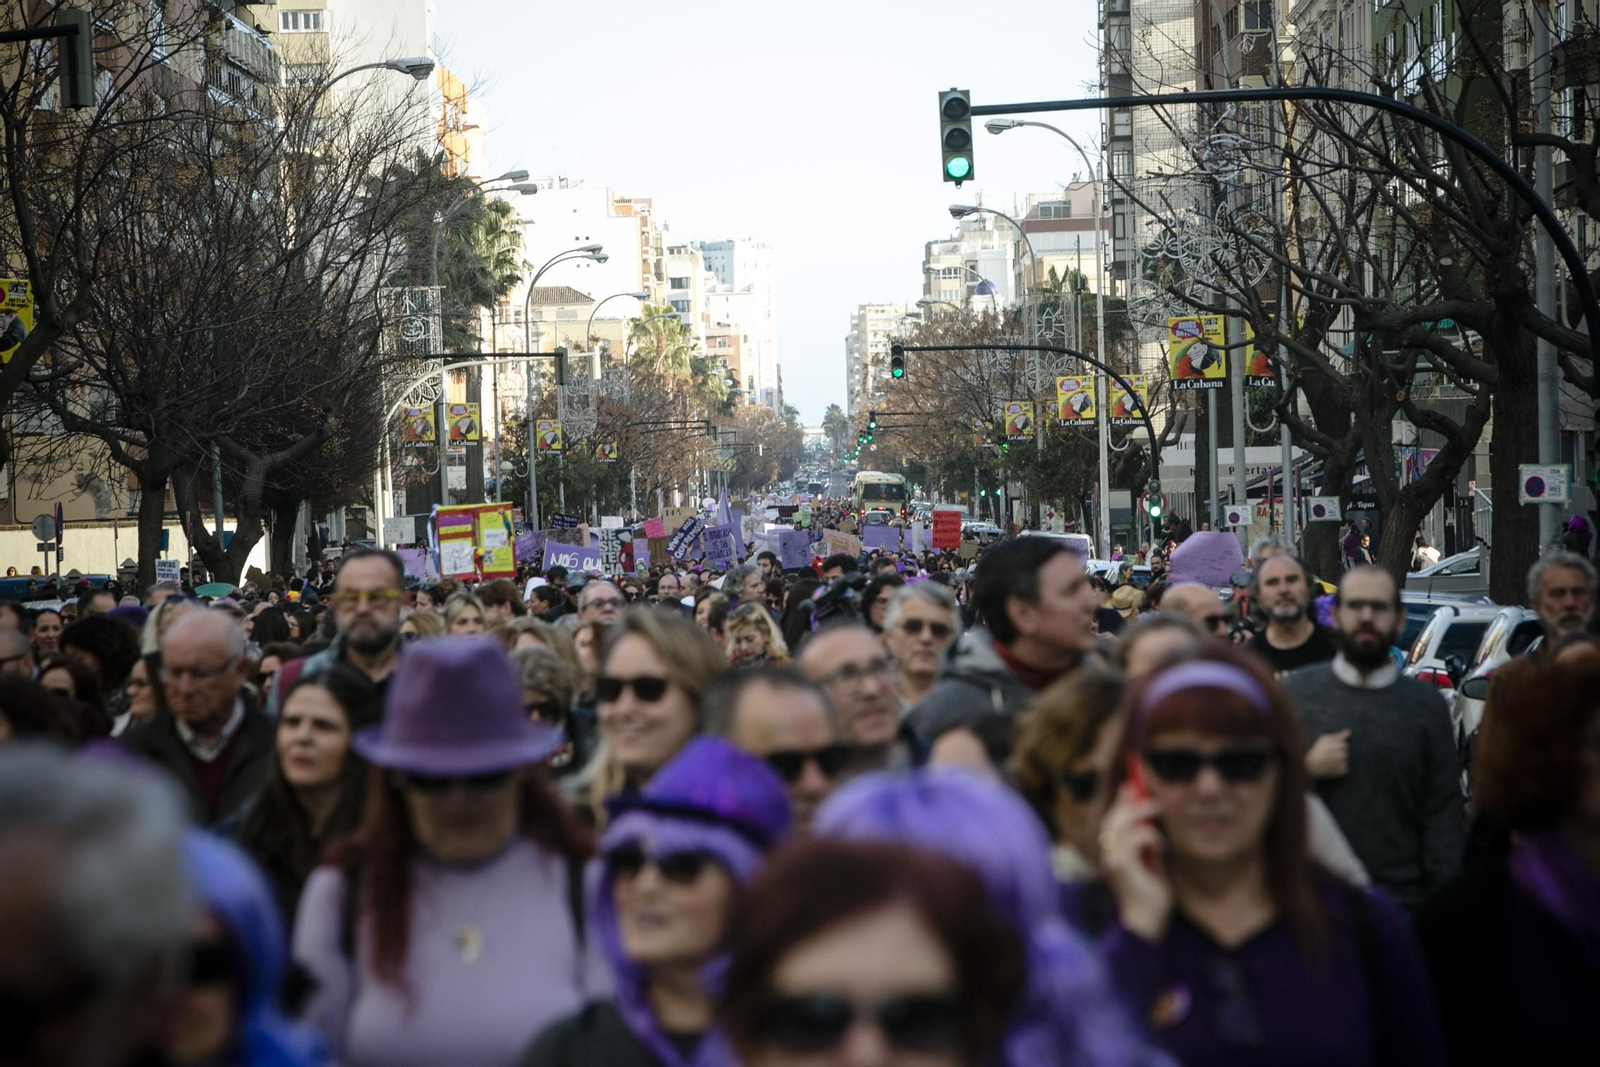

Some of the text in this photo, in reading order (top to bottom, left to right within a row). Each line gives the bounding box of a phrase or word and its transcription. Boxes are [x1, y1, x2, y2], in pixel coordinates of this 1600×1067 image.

[1174, 379, 1223, 391] La Cubana
[1248, 378, 1278, 388] La Cu
[1229, 466, 1277, 476] Perta
[1357, 501, 1376, 510] Tapas
[1257, 506, 1284, 518] RA-A-
[599, 529, 616, 541] RE
[674, 521, 704, 559] QUEREMOS
[600, 540, 622, 552] SIS
[667, 531, 685, 552] VIVAS
[157, 561, 177, 569] JUNTAS
[550, 552, 579, 568] NOS
[583, 556, 603, 572] QU
[602, 563, 625, 575] CIA
